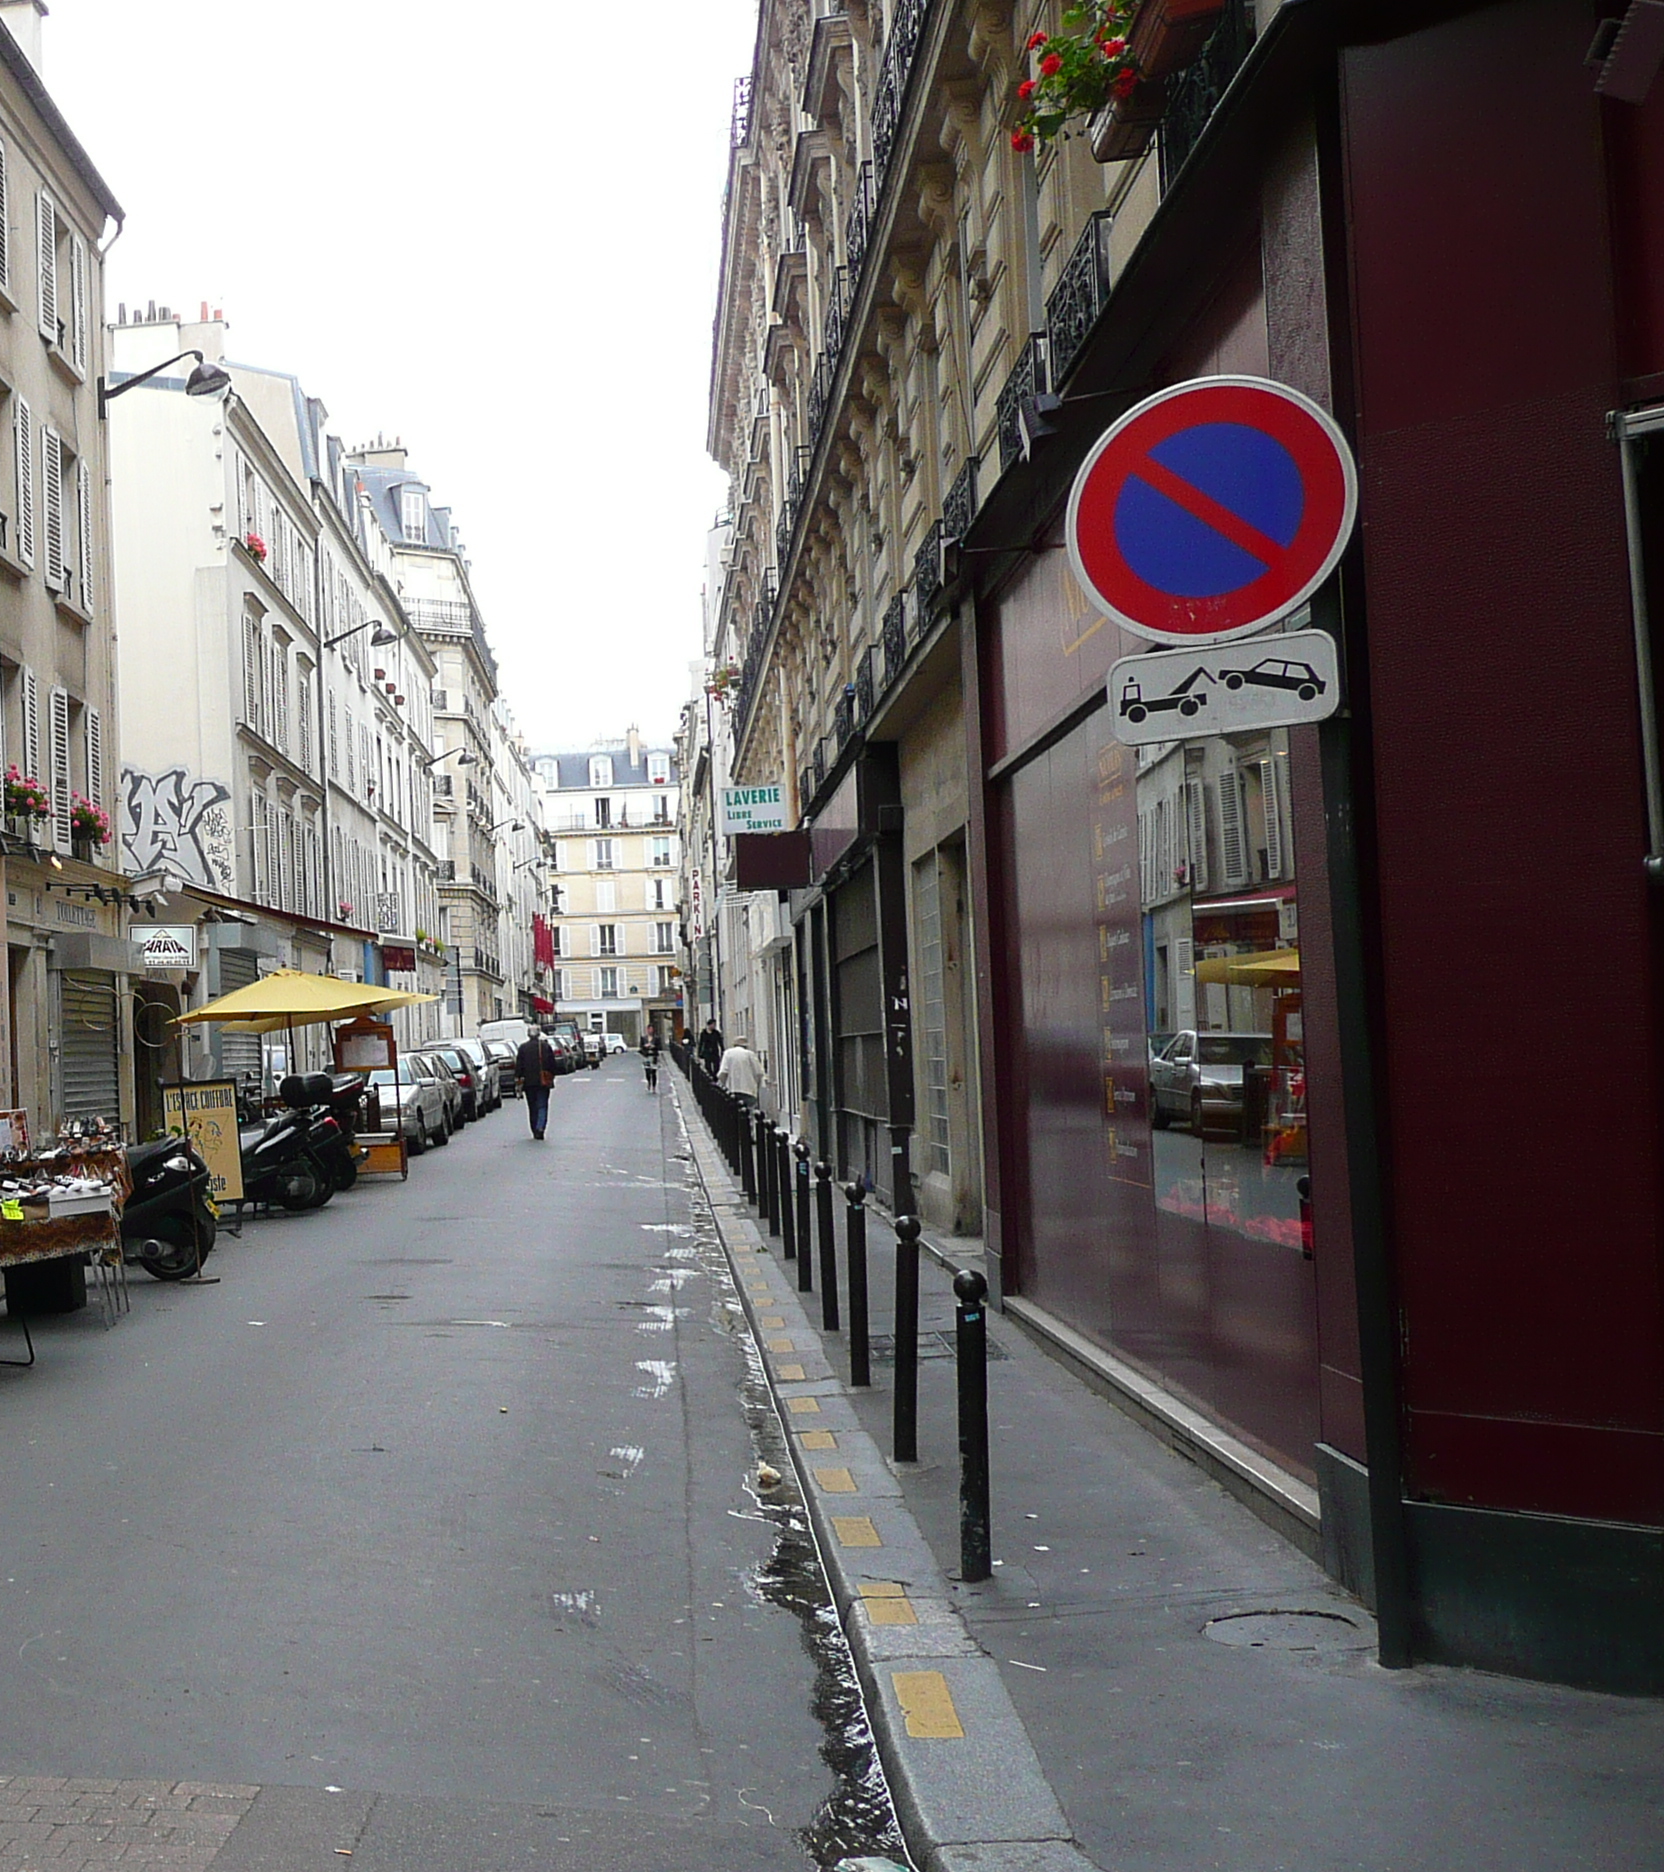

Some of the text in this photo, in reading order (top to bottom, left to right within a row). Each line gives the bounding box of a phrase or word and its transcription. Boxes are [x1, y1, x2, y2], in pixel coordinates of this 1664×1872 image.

[725, 787, 780, 807] LAVERIE
[746, 818, 783, 830] SERVICE
[200, 1088, 233, 1109] COIFFURE
